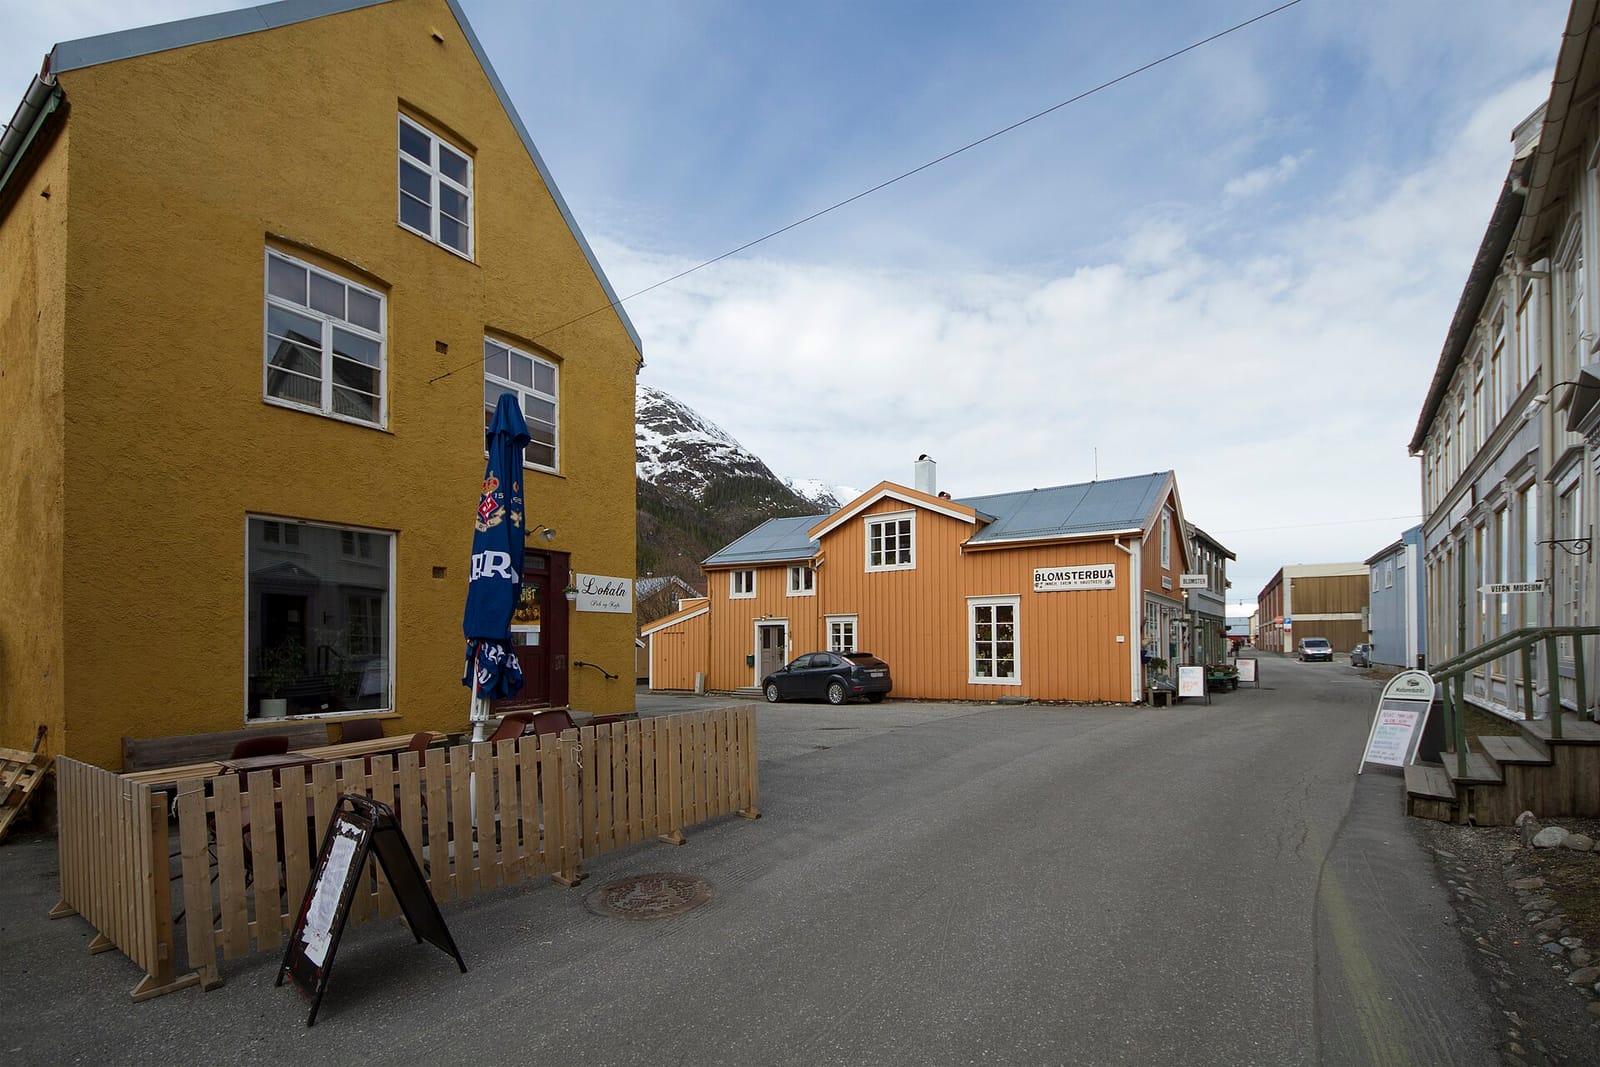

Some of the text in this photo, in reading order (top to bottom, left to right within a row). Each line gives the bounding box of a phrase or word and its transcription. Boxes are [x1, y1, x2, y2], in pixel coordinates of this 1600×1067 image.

[1035, 569, 1113, 582] BLOMSTERBUA
[582, 575, 626, 597] Lokaln
[1513, 584, 1541, 592] MUSEUM
